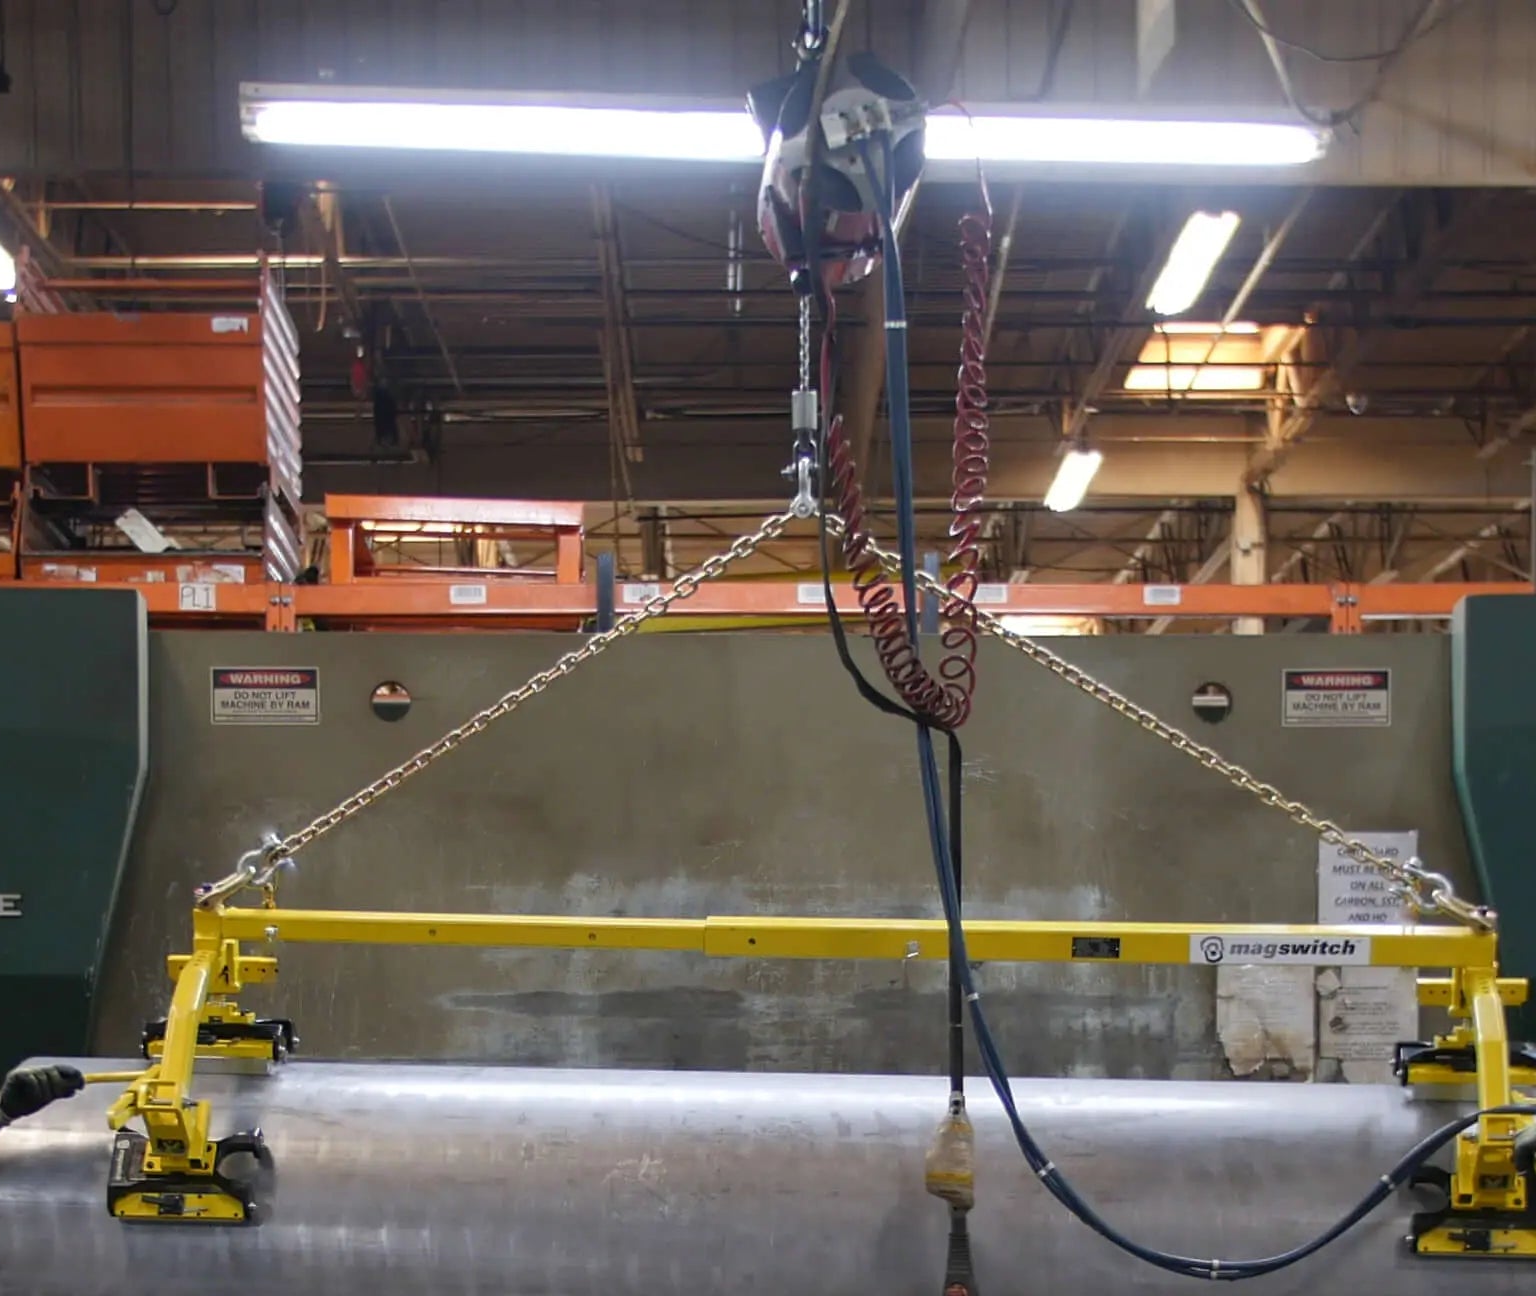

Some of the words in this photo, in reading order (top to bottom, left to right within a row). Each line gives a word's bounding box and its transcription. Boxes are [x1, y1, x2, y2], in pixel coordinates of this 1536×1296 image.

[229, 673, 302, 685] WARNING
[1301, 674, 1373, 687] WARNING
[233, 690, 250, 700] DO
[251, 690, 272, 700] NOT
[275, 690, 297, 700] LIFT
[220, 700, 265, 710] MACHINE
[270, 700, 285, 710] BY
[287, 700, 311, 710] RAM
[1230, 939, 1356, 959] magswitch
